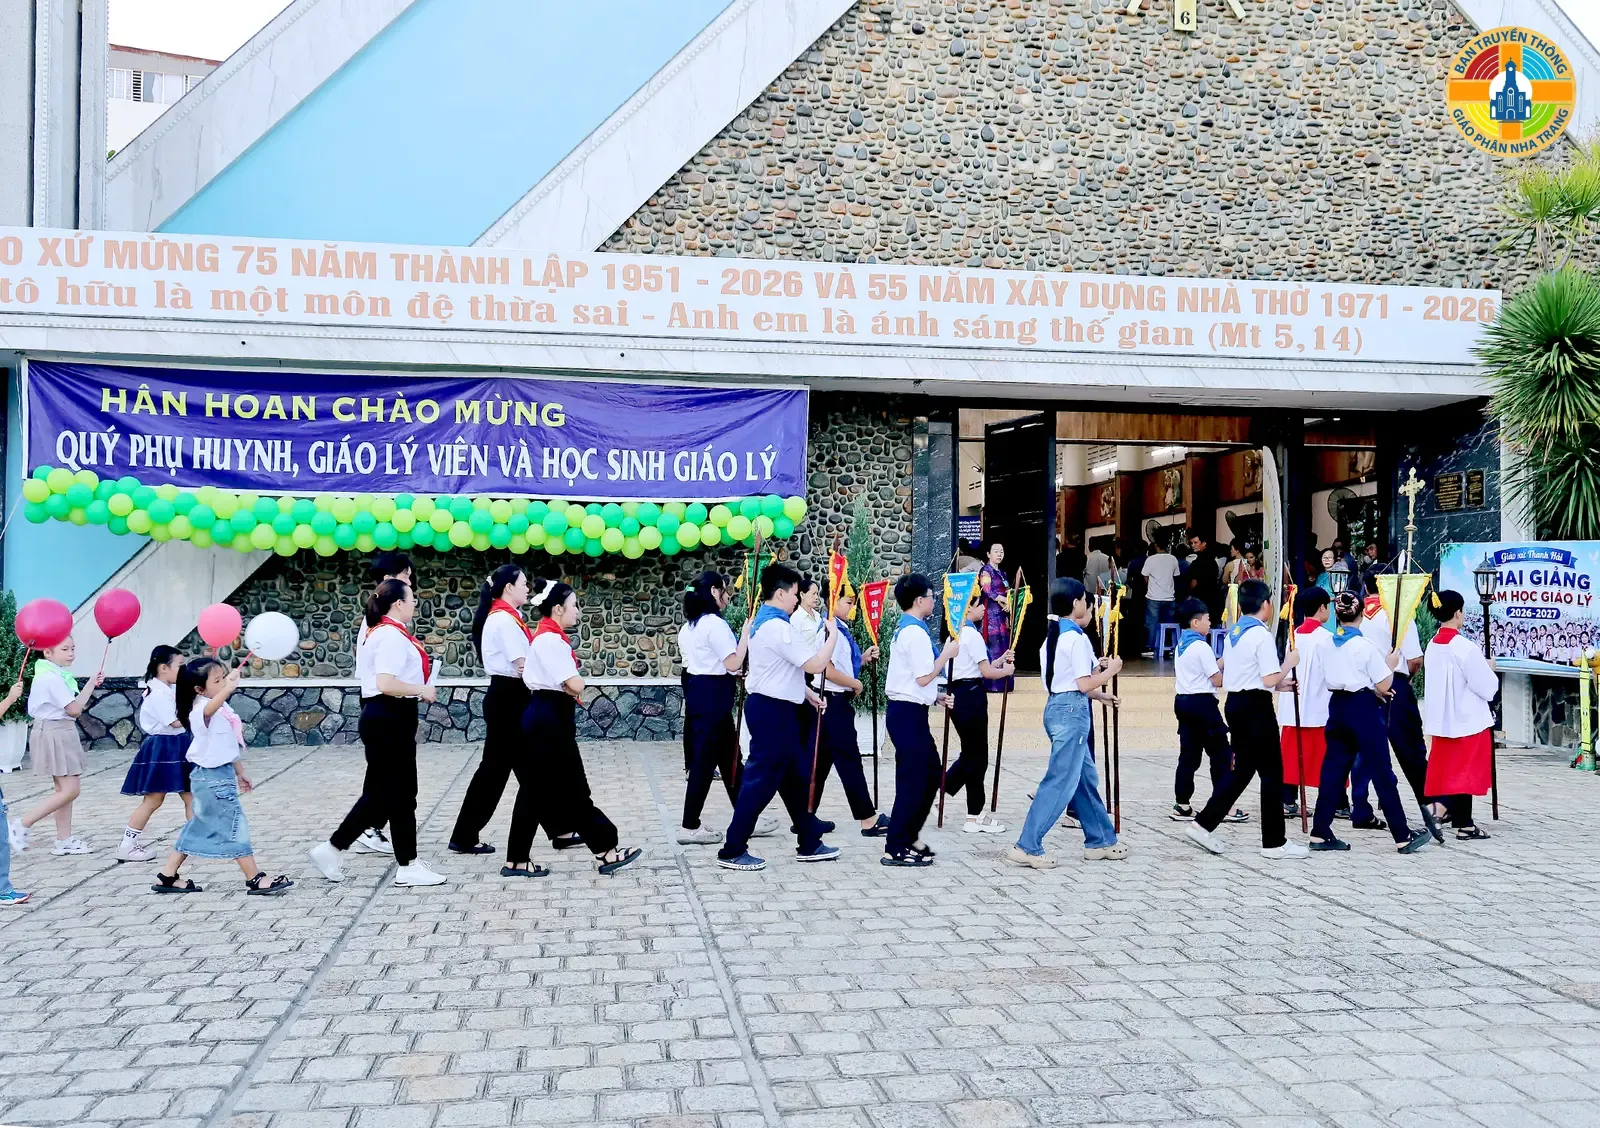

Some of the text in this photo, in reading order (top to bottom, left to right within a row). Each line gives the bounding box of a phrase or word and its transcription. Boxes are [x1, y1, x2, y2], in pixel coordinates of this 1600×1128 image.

[1180, 11, 1190, 25] 6
[38, 232, 94, 268] XỨ
[104, 235, 219, 273] MỪNG
[232, 246, 278, 276] 75
[291, 244, 377, 281] NĂM
[391, 249, 511, 285] THÀNH
[523, 253, 589, 293] LẬP
[602, 263, 681, 293] 1951
[720, 267, 803, 298] 2026
[814, 267, 857, 300] VÀ
[868, 274, 908, 301] 55
[919, 271, 995, 305] NĂM
[1006, 274, 1070, 308] XÂY
[1079, 281, 1167, 315] DỰNG
[1177, 282, 1241, 315] NHÀ
[1251, 283, 1312, 317] THỜ
[1321, 292, 1390, 320] 1971
[1422, 295, 1496, 323] 2026
[0, 277, 40, 304] tô
[56, 277, 138, 307] hữu
[154, 280, 194, 309] là
[210, 287, 289, 317] một
[303, 290, 392, 318] môn
[407, 291, 455, 325] đệ
[469, 294, 557, 324] thừa
[572, 300, 629, 327] sai
[667, 302, 739, 331] Anh
[753, 311, 809, 333] em
[823, 308, 857, 335] là
[871, 310, 940, 337] ánh
[953, 314, 1038, 346] sáng
[1050, 317, 1110, 343] thế
[1118, 319, 1194, 349] gian
[1208, 321, 1262, 352] (Mt
[1275, 323, 1363, 356] 5,14)
[101, 383, 567, 428] HÂN HOAN CHÀO MỪNG
[56, 425, 778, 487] QUÝ PHỤ HUYNH, GIÁO LÝ VIÊN VÀ HỌC SINH GIÁO LÝ
[1501, 552, 1516, 563] Giáo
[1527, 550, 1549, 559] Thanh
[1496, 566, 1591, 590] HAI GIẢNG
[1511, 590, 1537, 604] HỌC
[1541, 589, 1573, 604] GIÁO
[1577, 592, 1593, 606] LÝ
[1510, 608, 1558, 619] 2026-2027
